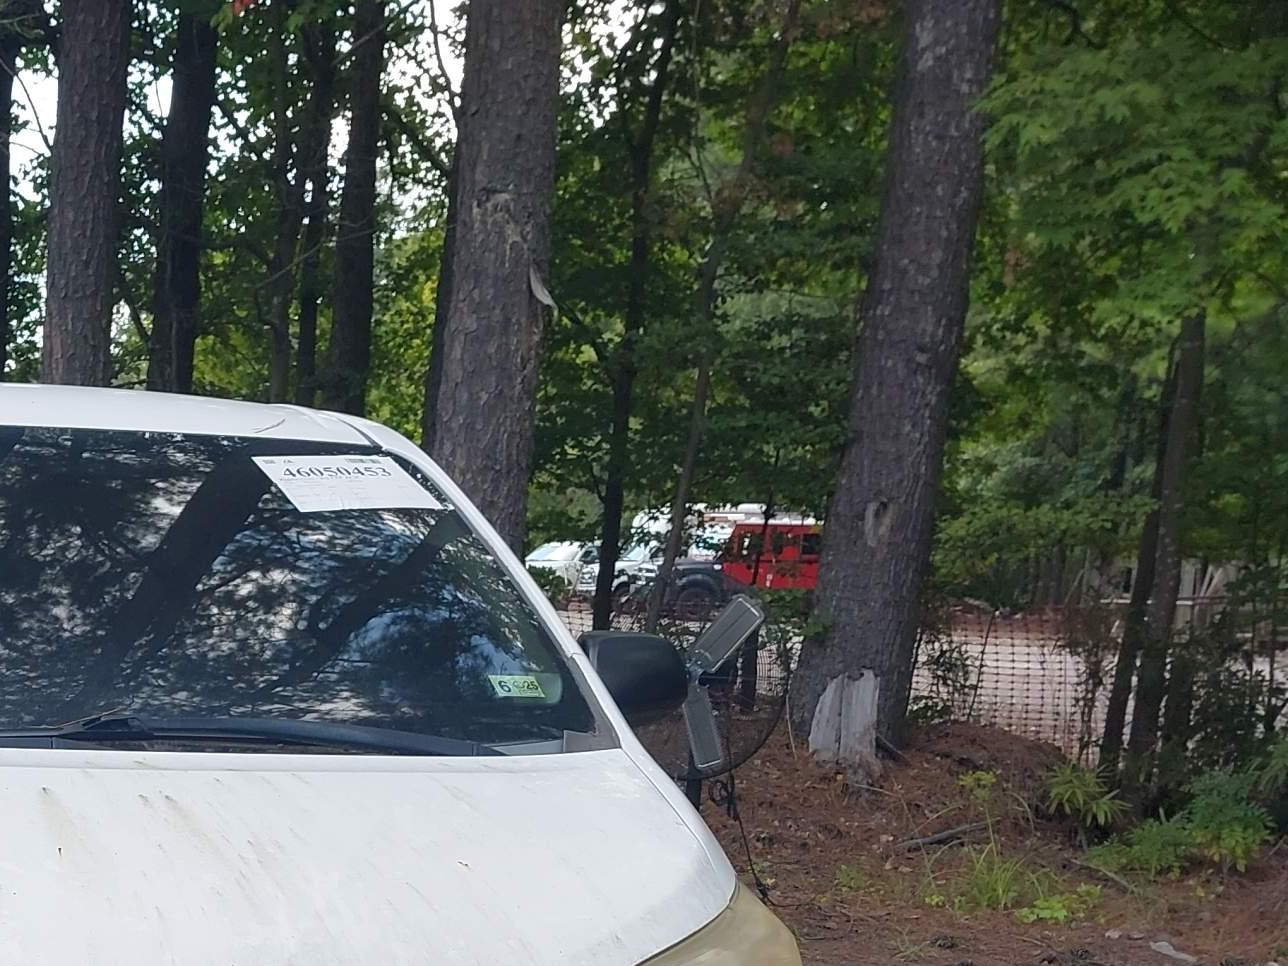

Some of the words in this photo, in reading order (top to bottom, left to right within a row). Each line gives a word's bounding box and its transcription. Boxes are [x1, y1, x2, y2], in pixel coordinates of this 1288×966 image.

[283, 466, 392, 478] 46050453
[498, 680, 512, 692] 6
[522, 680, 539, 690] 25
